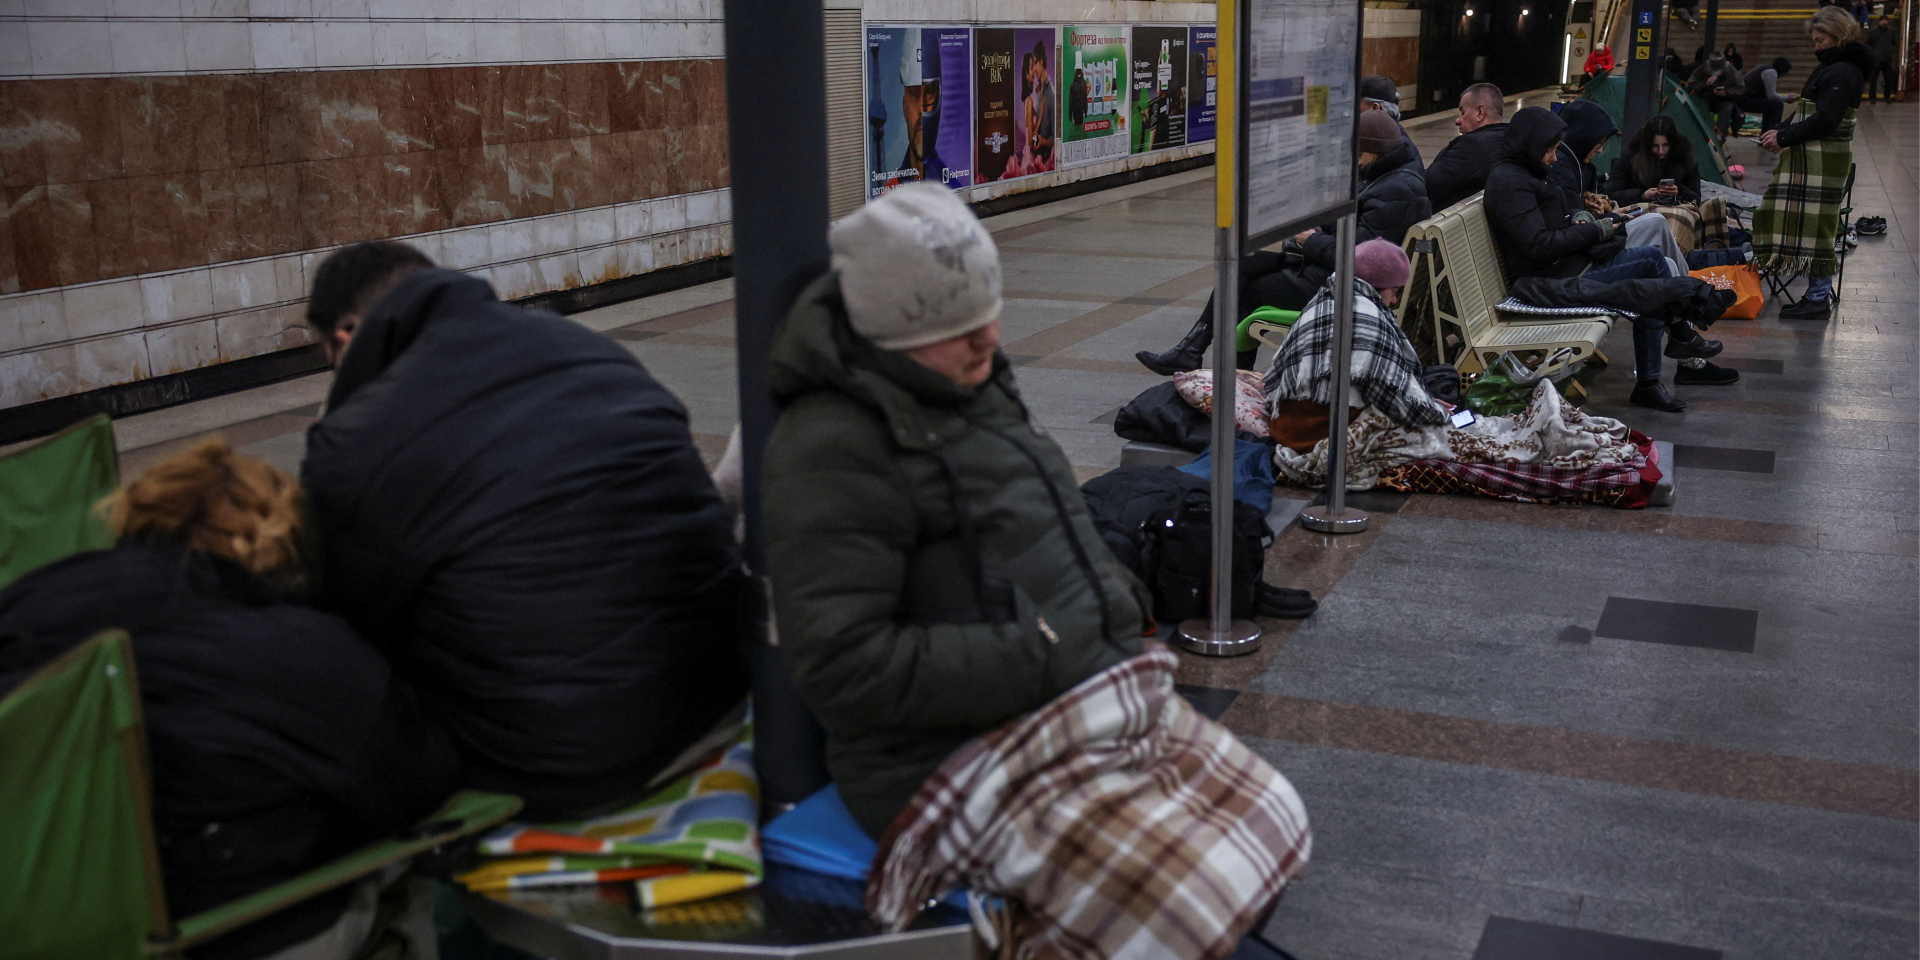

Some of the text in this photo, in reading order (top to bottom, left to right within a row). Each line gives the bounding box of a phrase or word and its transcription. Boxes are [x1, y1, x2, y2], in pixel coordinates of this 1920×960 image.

[1070, 31, 1097, 49] Фортеза
[871, 171, 886, 182] Зима
[949, 169, 970, 180] Нафтогаз
